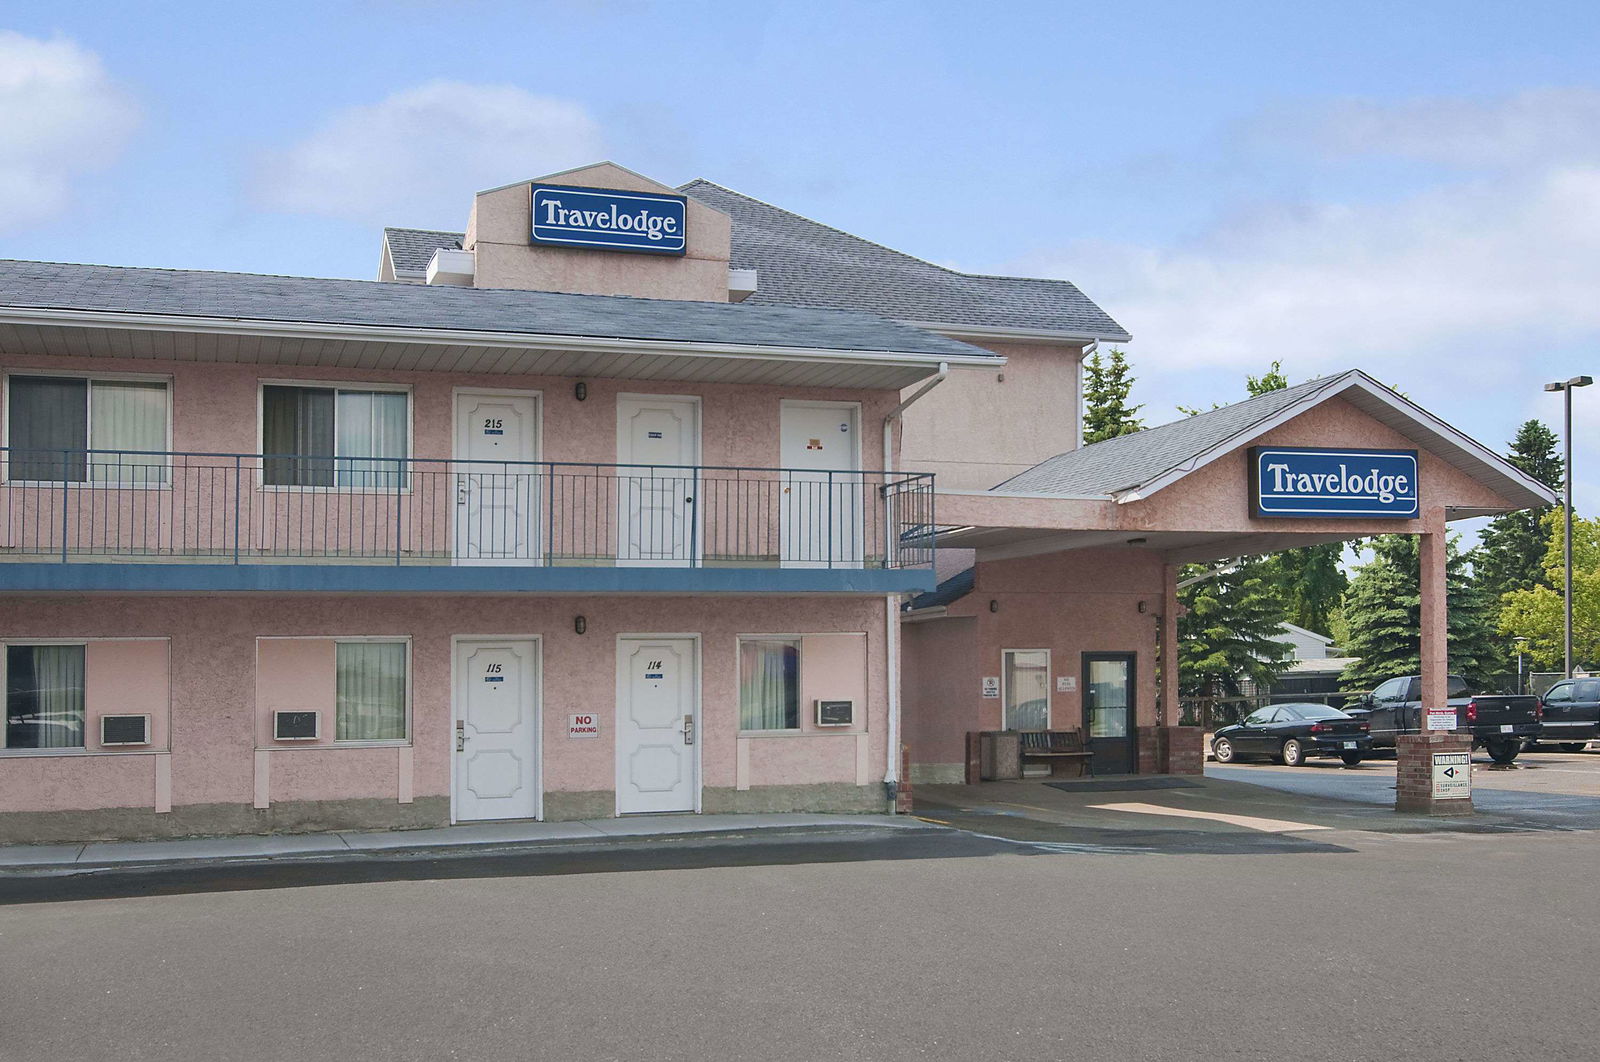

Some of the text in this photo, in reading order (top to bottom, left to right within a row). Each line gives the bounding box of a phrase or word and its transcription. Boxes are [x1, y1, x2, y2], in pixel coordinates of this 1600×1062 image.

[541, 199, 677, 240] Travelodge
[484, 419, 502, 428] 215
[1267, 463, 1408, 503] Travelodge
[486, 663, 502, 673] 115
[647, 661, 661, 670] 114
[575, 715, 592, 725] NO
[1434, 755, 1468, 765] WARNING!
